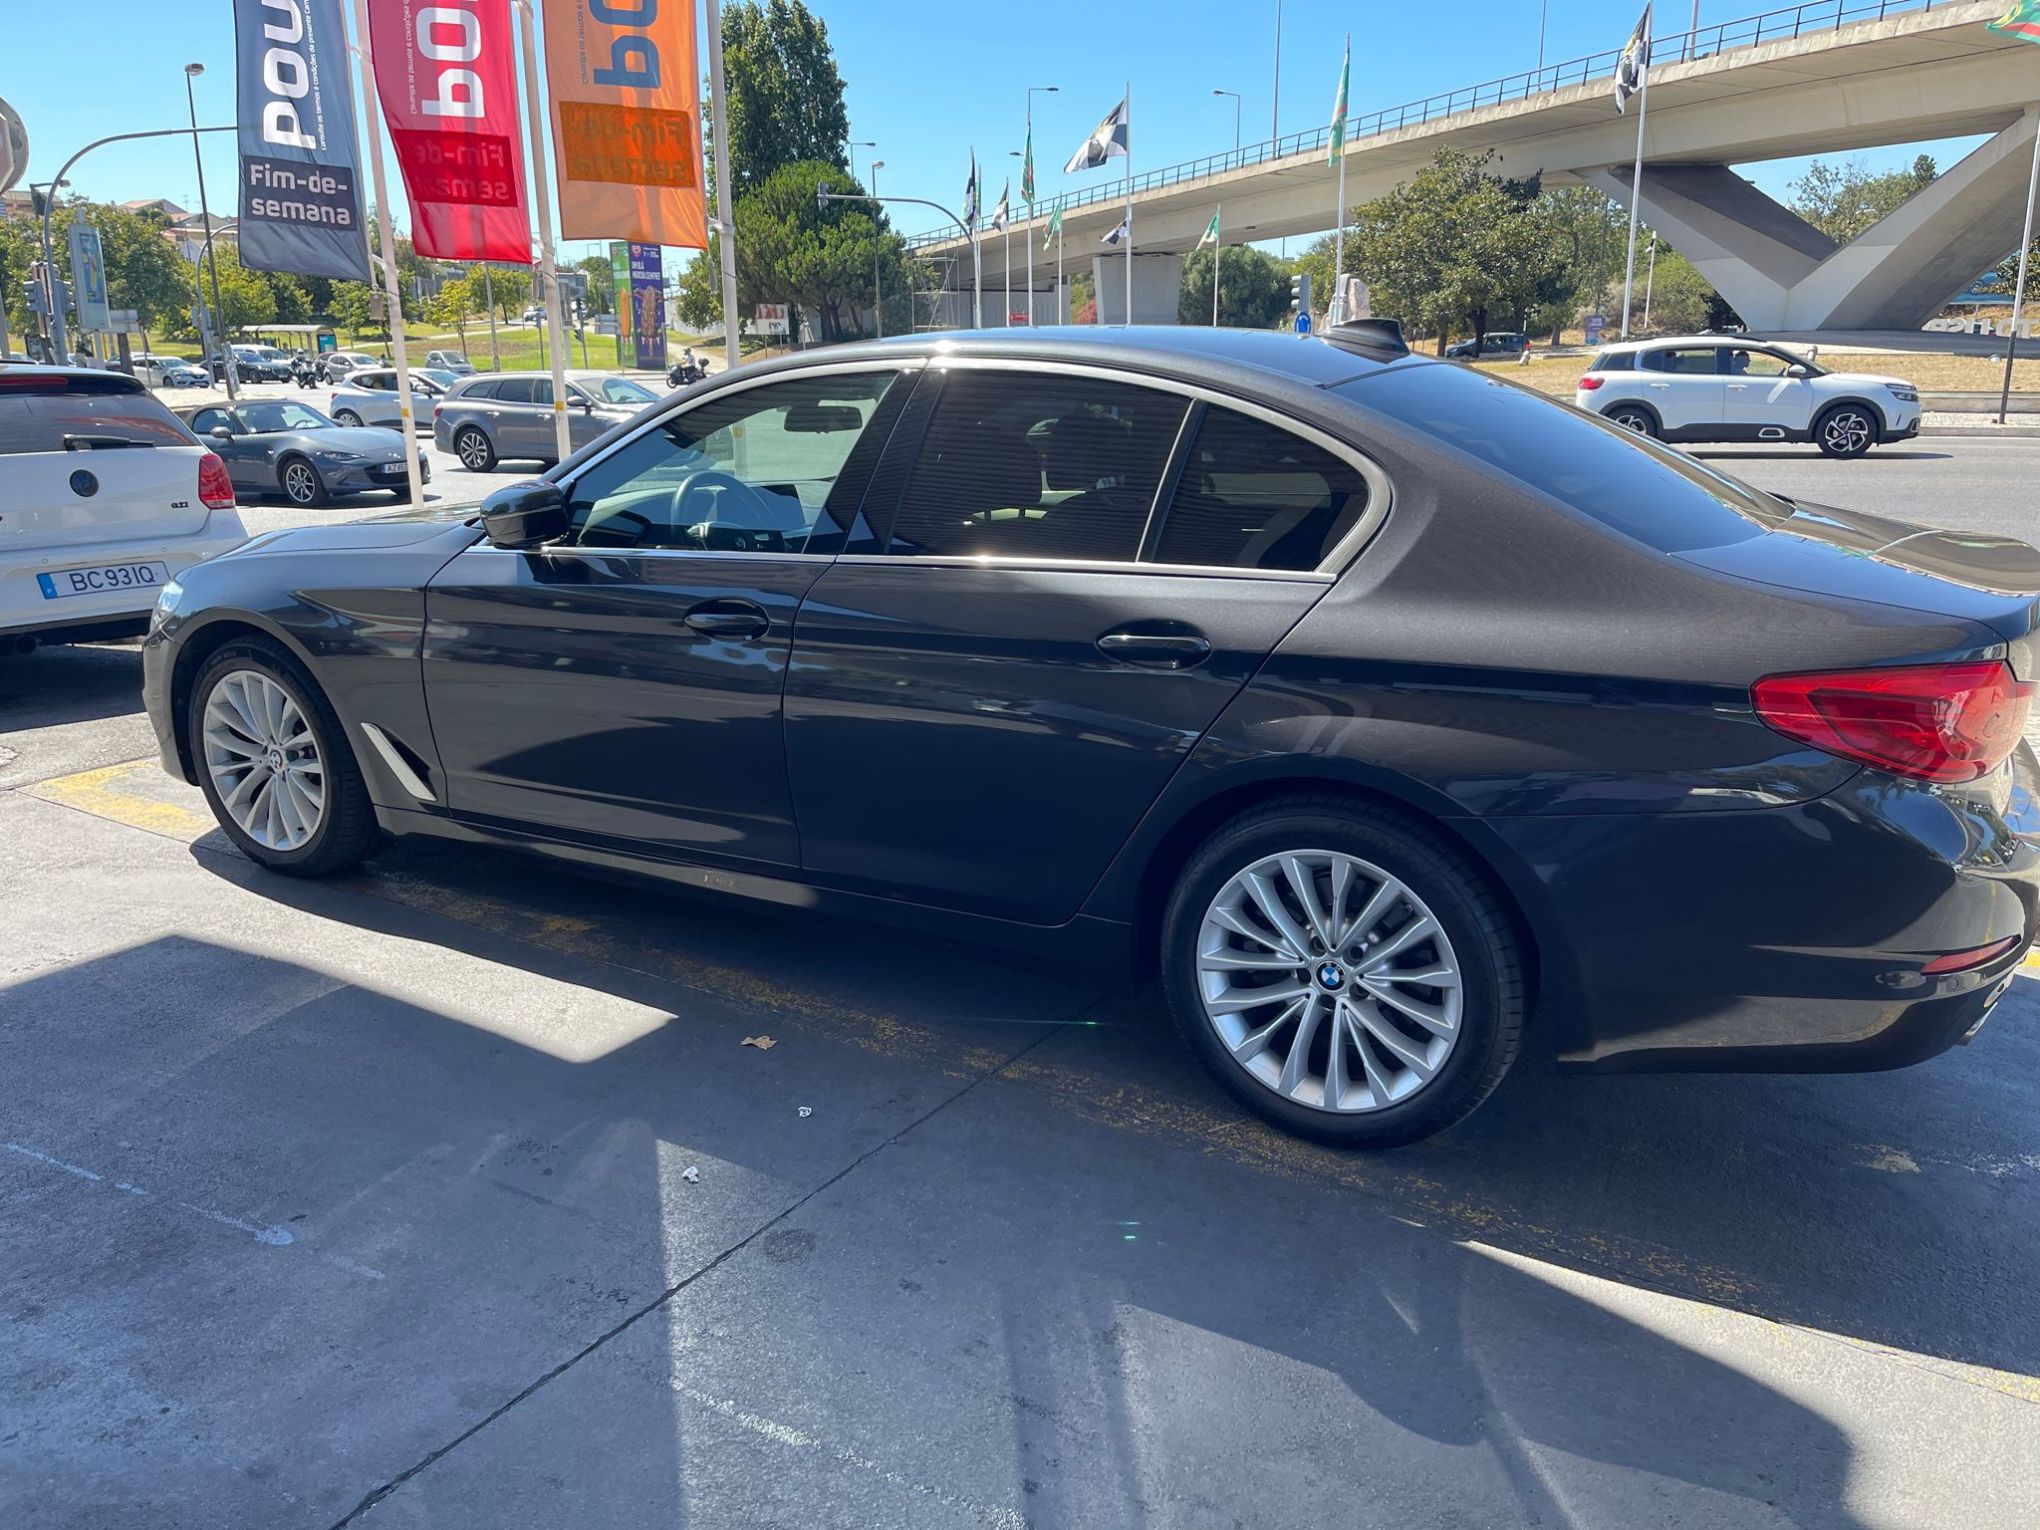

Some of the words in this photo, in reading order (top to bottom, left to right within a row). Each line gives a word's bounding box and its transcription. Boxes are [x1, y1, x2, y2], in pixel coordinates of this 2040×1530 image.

[305, 15, 316, 44] presente
[308, 44, 315, 53] da
[317, 114, 323, 122] os
[318, 124, 327, 151] Consulte
[250, 163, 348, 195] Fim-de-
[251, 197, 351, 226] semana
